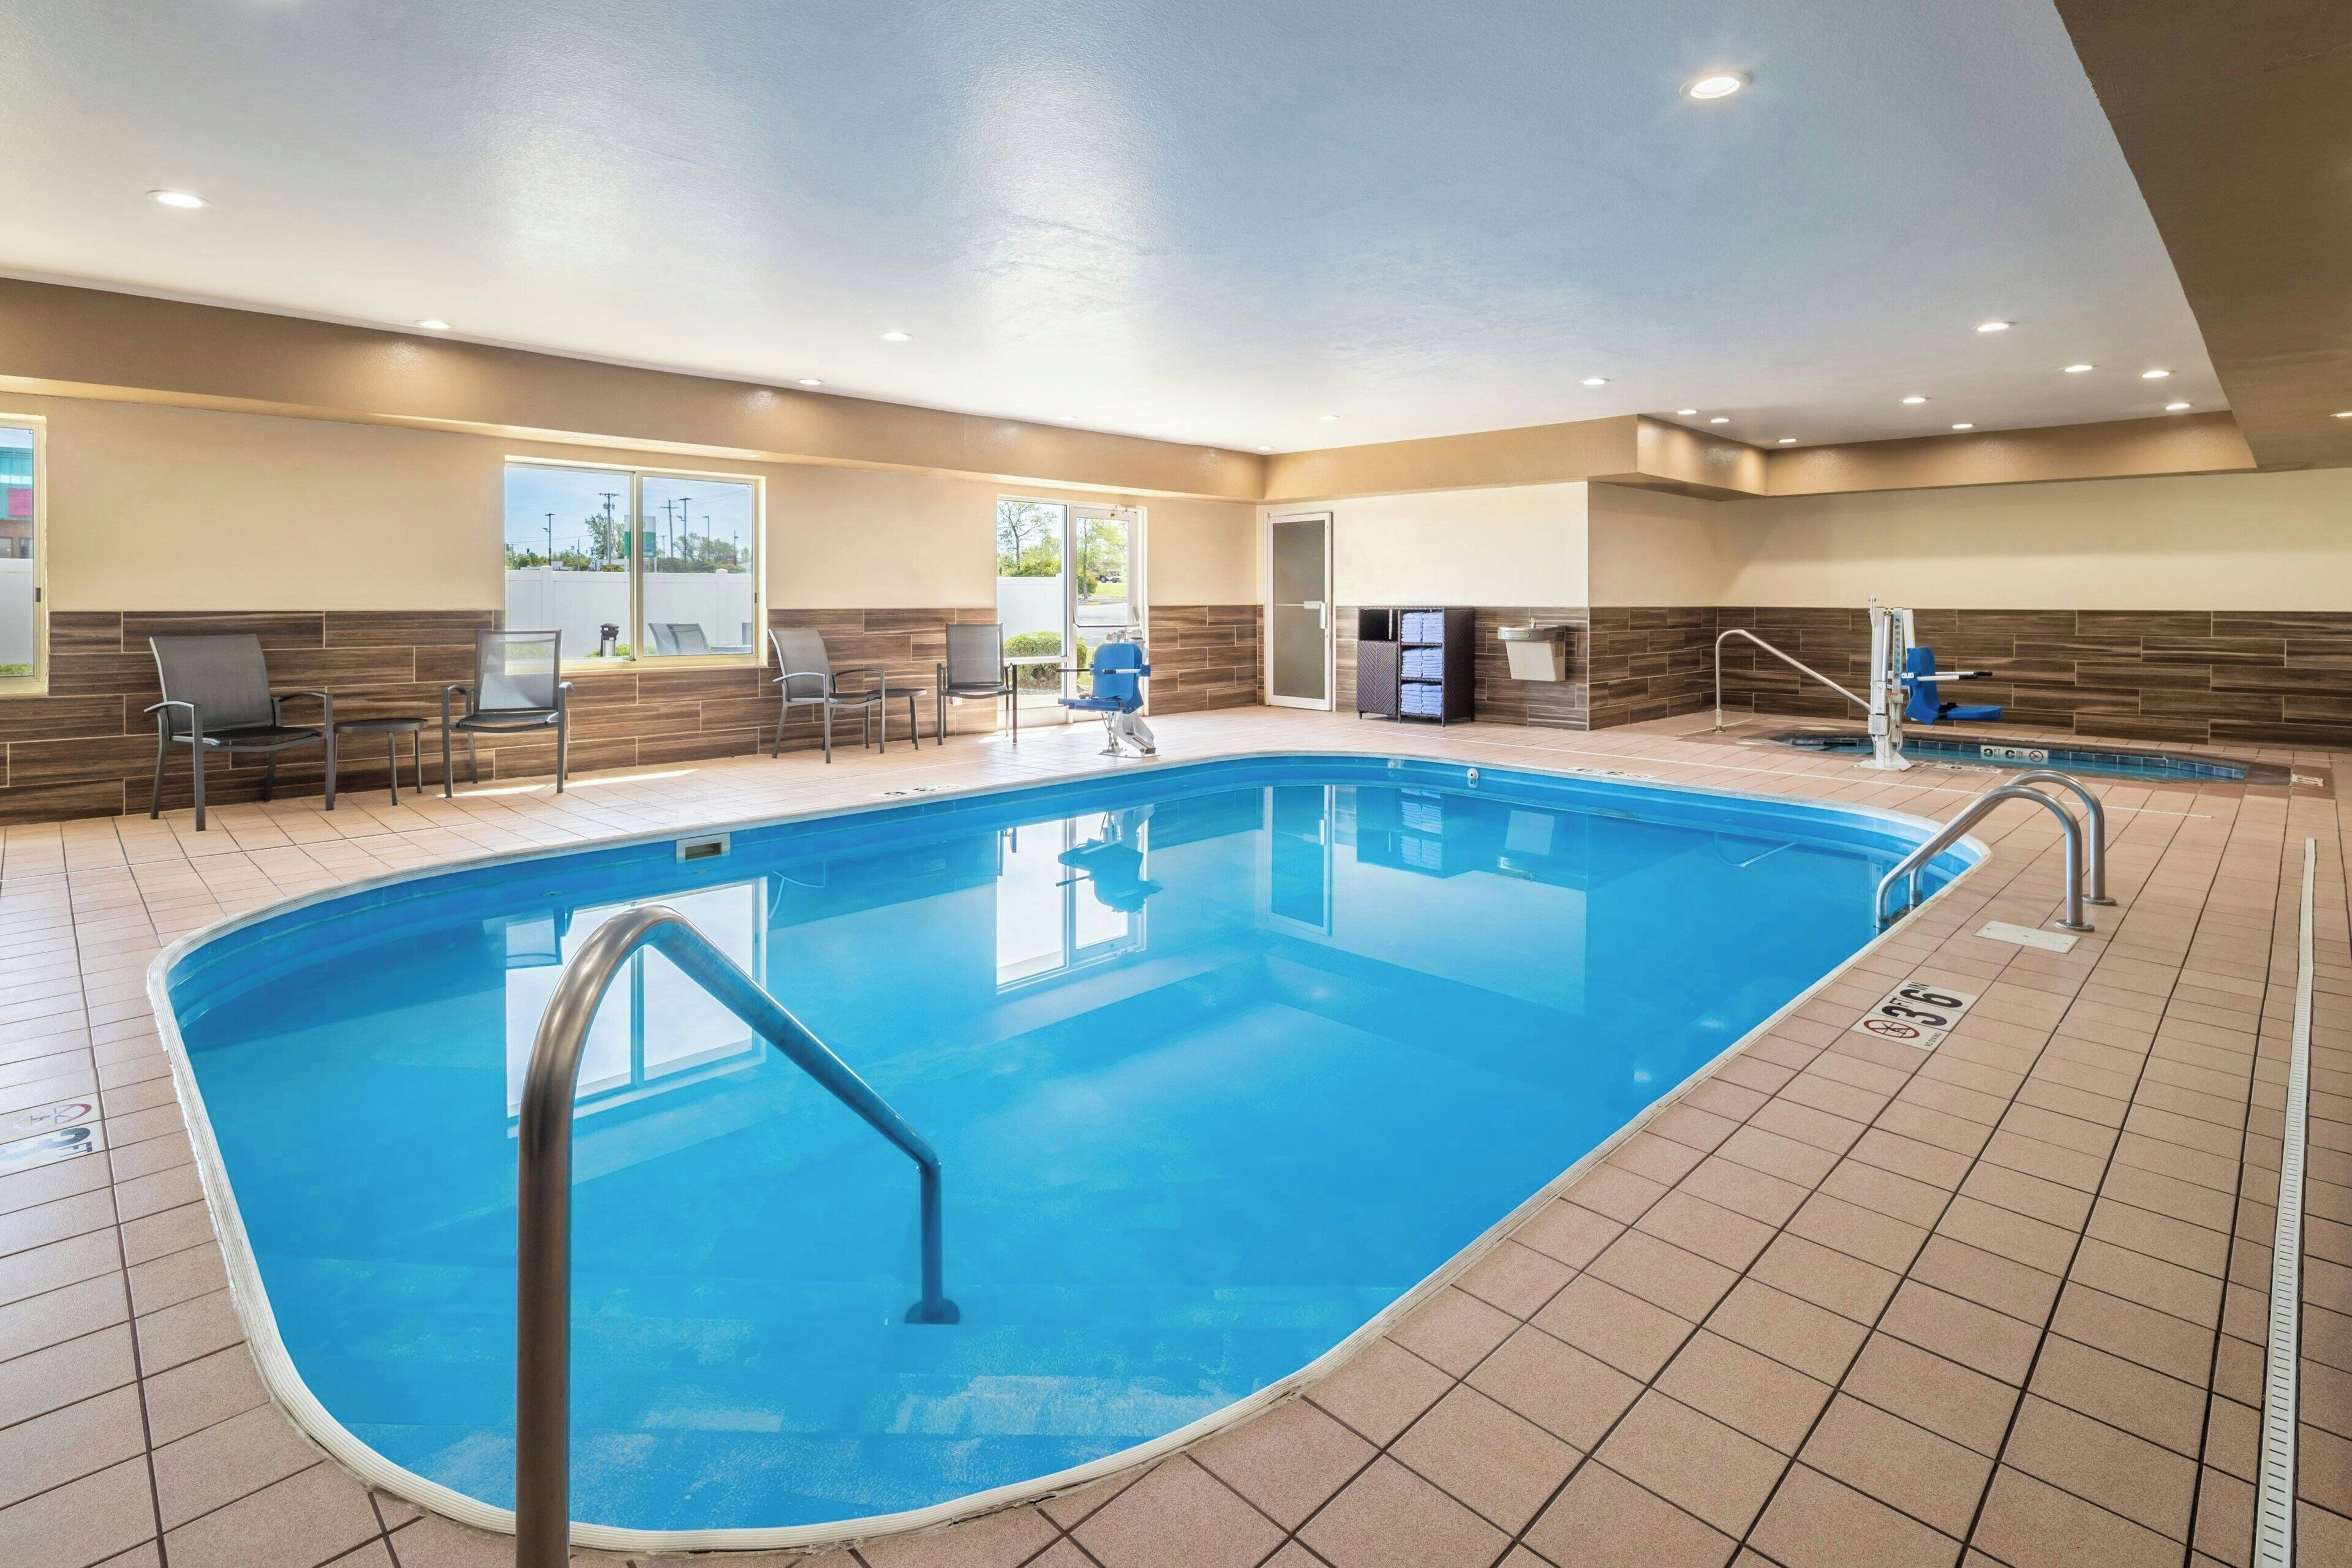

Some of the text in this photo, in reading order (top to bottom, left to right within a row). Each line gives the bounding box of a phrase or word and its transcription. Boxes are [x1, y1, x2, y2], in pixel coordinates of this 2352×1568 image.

[1881, 981, 1963, 1026] 3 FT 6 IN
[58, 1141, 93, 1158] FT
